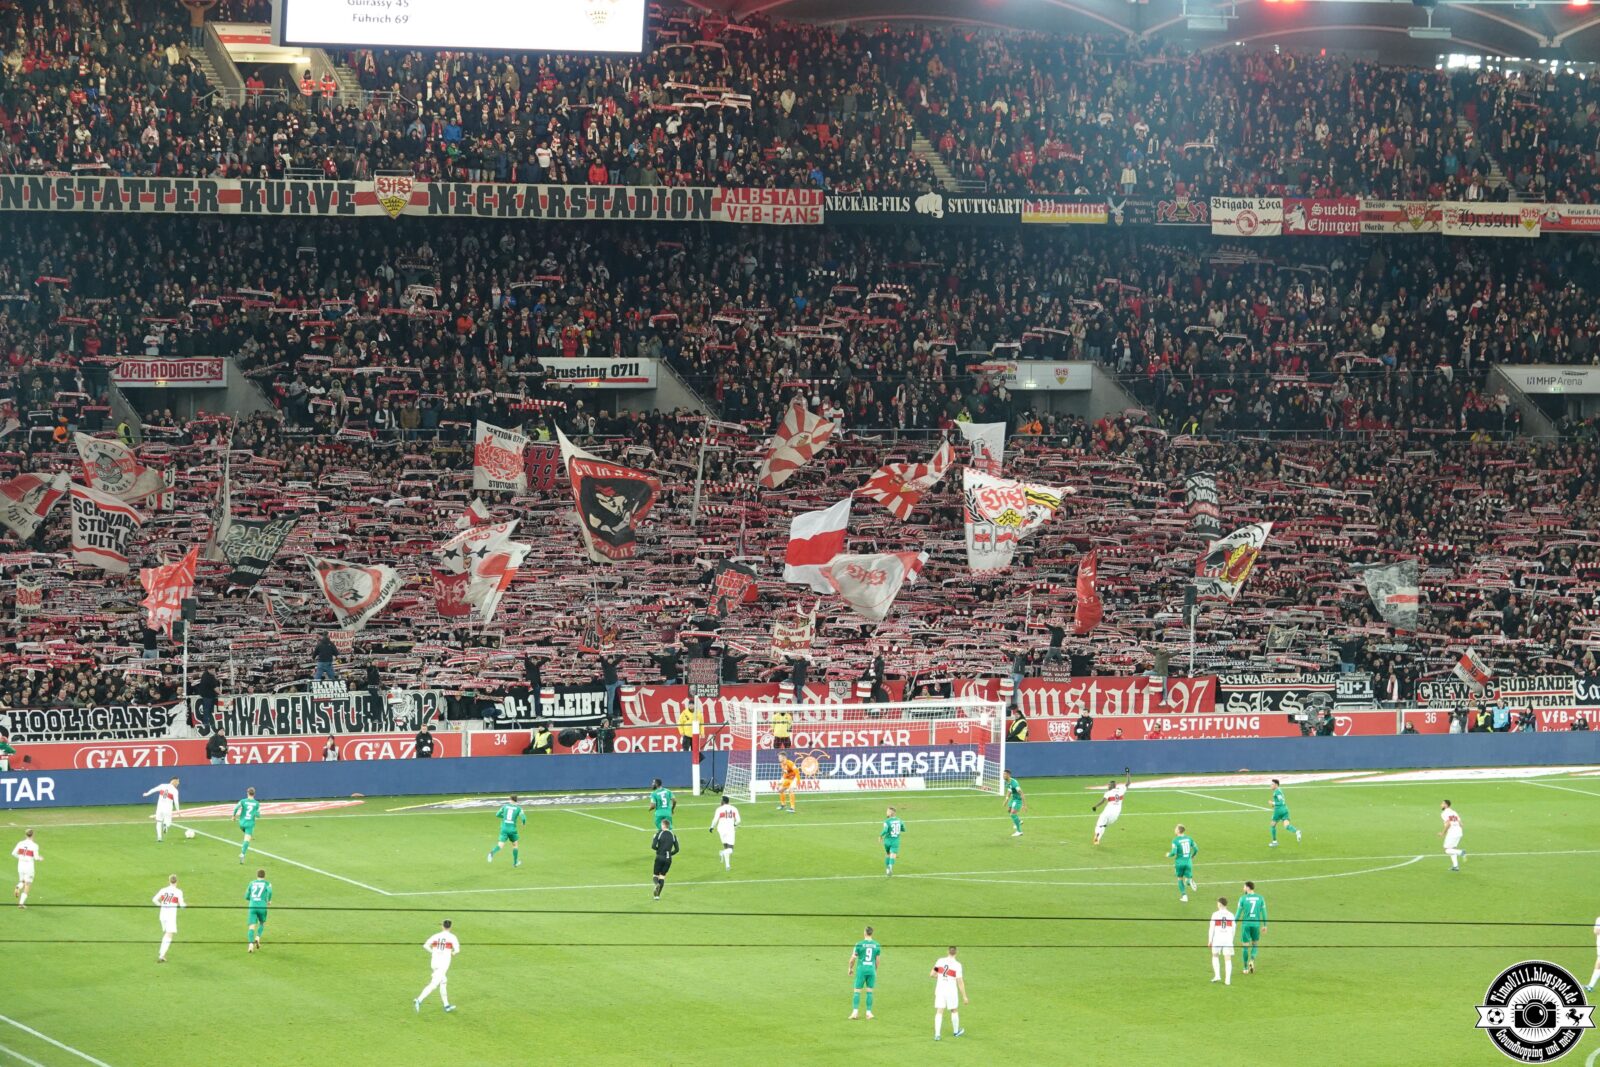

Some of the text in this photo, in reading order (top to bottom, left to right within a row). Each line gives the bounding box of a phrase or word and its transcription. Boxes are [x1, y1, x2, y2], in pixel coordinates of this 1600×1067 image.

[1, 177, 356, 215] NNSTATTER KURVE
[428, 183, 713, 220] NECKARSTADION
[725, 188, 822, 205] ALBSTADT
[825, 195, 1022, 215] NECKAR-FILS STUTTGART
[1038, 198, 1106, 218] Warriors
[1212, 198, 1282, 211] Brigada Loca
[1311, 202, 1356, 217] Suebia
[727, 205, 820, 223] VFB-FANS
[611, 363, 639, 377] 0711
[1536, 376, 1583, 386] MHP Arena
[311, 680, 347, 689] ULTRAS
[1335, 680, 1374, 694] 50+1
[1420, 682, 1470, 700] CREW
[1501, 695, 1574, 707] STUTTGART
[7, 706, 167, 733] HOOLIGANS
[1143, 716, 1260, 733] VfB-STIFTUNG
[1425, 712, 1437, 724] 36
[957, 721, 969, 733] 35
[494, 733, 507, 745] 34
[355, 741, 417, 760] GAZ
[829, 751, 978, 776] JOKERSTAR
[1, 777, 56, 802] TAR
[856, 779, 906, 790] WINAMAX
[662, 793, 667, 805] 5
[252, 882, 264, 895] 27
[1250, 900, 1257, 914] 7
[437, 938, 446, 951] 16
[865, 947, 873, 961] 9
[942, 965, 949, 978] 2
